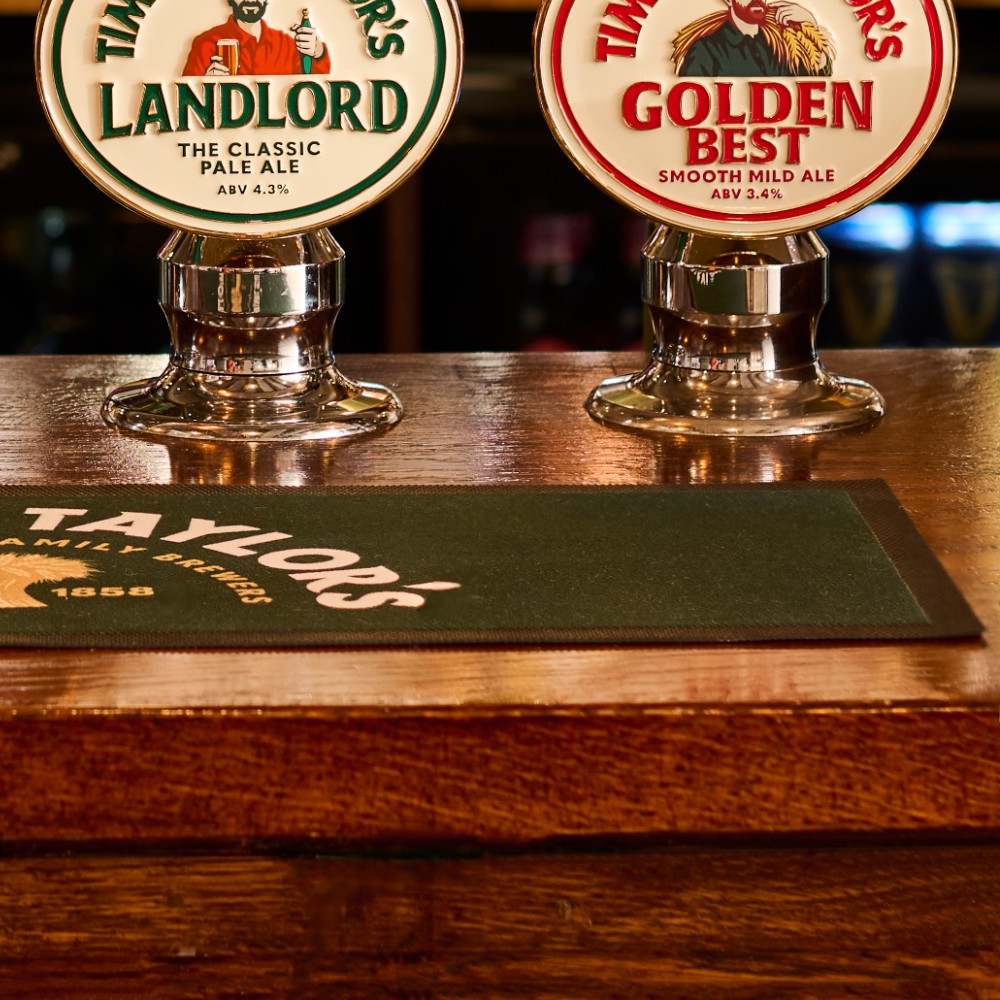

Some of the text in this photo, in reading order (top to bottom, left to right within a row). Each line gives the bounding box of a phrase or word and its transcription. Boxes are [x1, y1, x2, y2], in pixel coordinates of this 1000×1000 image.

[99, 80, 408, 139] LANDLORD
[621, 80, 875, 131] GOLDEN
[178, 141, 321, 158] THE CLASSIC
[687, 127, 810, 165] BEST
[200, 159, 300, 175] PALE ALE
[658, 169, 835, 183] SMOOTH MILD ALE
[217, 184, 290, 196] ABV 4.3%
[711, 188, 783, 200] ABV 3.4%
[24, 507, 462, 610] TAYLOR'S
[152, 552, 273, 605] BREWERS
[51, 586, 155, 598] 1858
